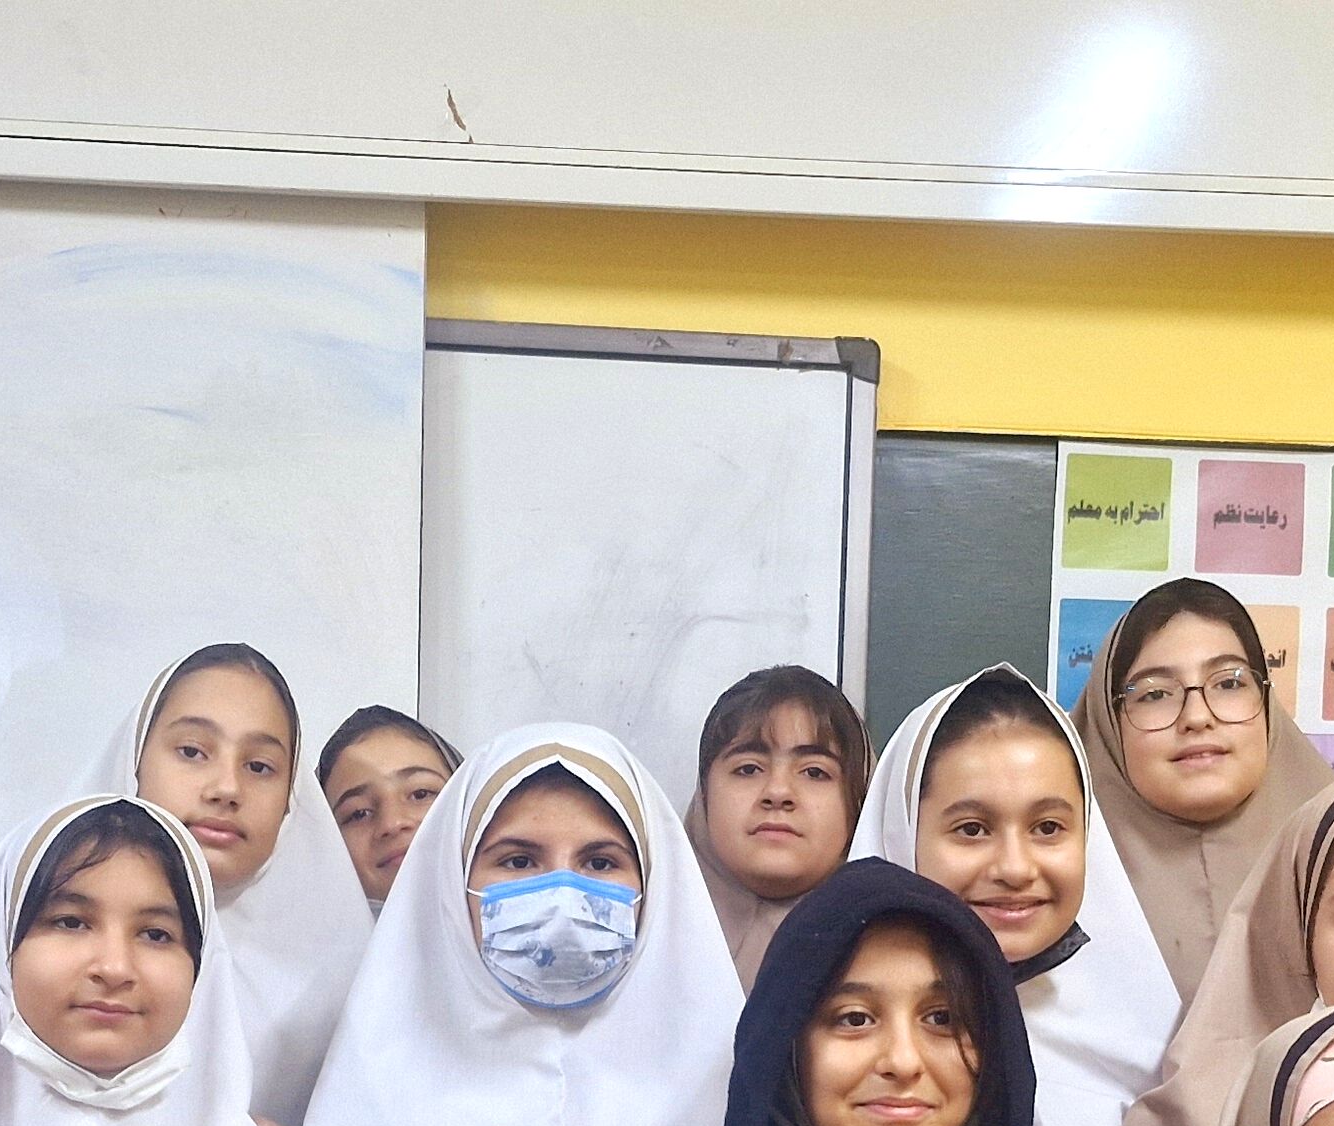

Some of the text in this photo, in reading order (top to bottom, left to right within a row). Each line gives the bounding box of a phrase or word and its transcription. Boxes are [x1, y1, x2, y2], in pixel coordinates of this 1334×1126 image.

[1067, 499, 1165, 526] احترام به معلم
[1213, 504, 1288, 530] رعایت نظم
